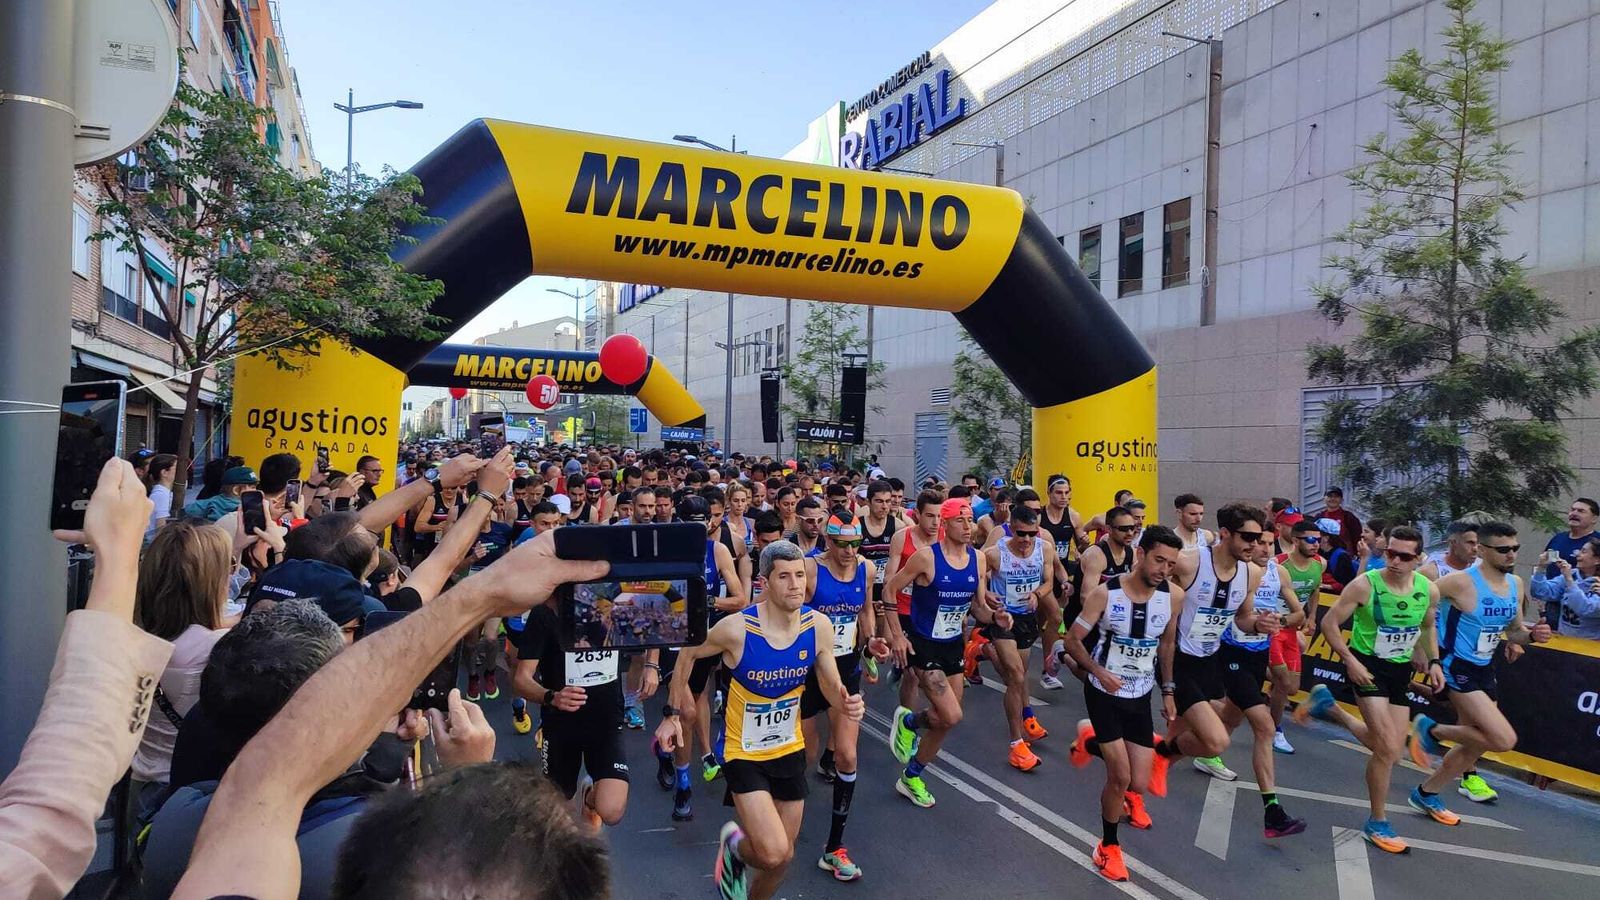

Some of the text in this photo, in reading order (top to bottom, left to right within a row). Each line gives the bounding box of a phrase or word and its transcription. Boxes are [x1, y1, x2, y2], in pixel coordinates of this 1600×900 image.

[844, 50, 934, 123] CENTRO COMERCIAL
[565, 151, 970, 251] MARCELINO
[613, 234, 924, 279] www.mpmarcelino.es
[453, 353, 603, 383] MARCELINO
[540, 384, 558, 404] 50
[247, 407, 388, 438] agustinos
[670, 430, 689, 438] CAJÓN
[809, 427, 843, 439] CAJÓN 1
[264, 437, 369, 454] GRANADA
[1015, 583, 1033, 593] 611
[1205, 615, 1228, 626] 392
[1385, 632, 1417, 643] 1917
[574, 650, 613, 663] 2634
[1119, 645, 1151, 658] 1382
[747, 665, 809, 685] agustinos
[754, 708, 792, 727] 1108
